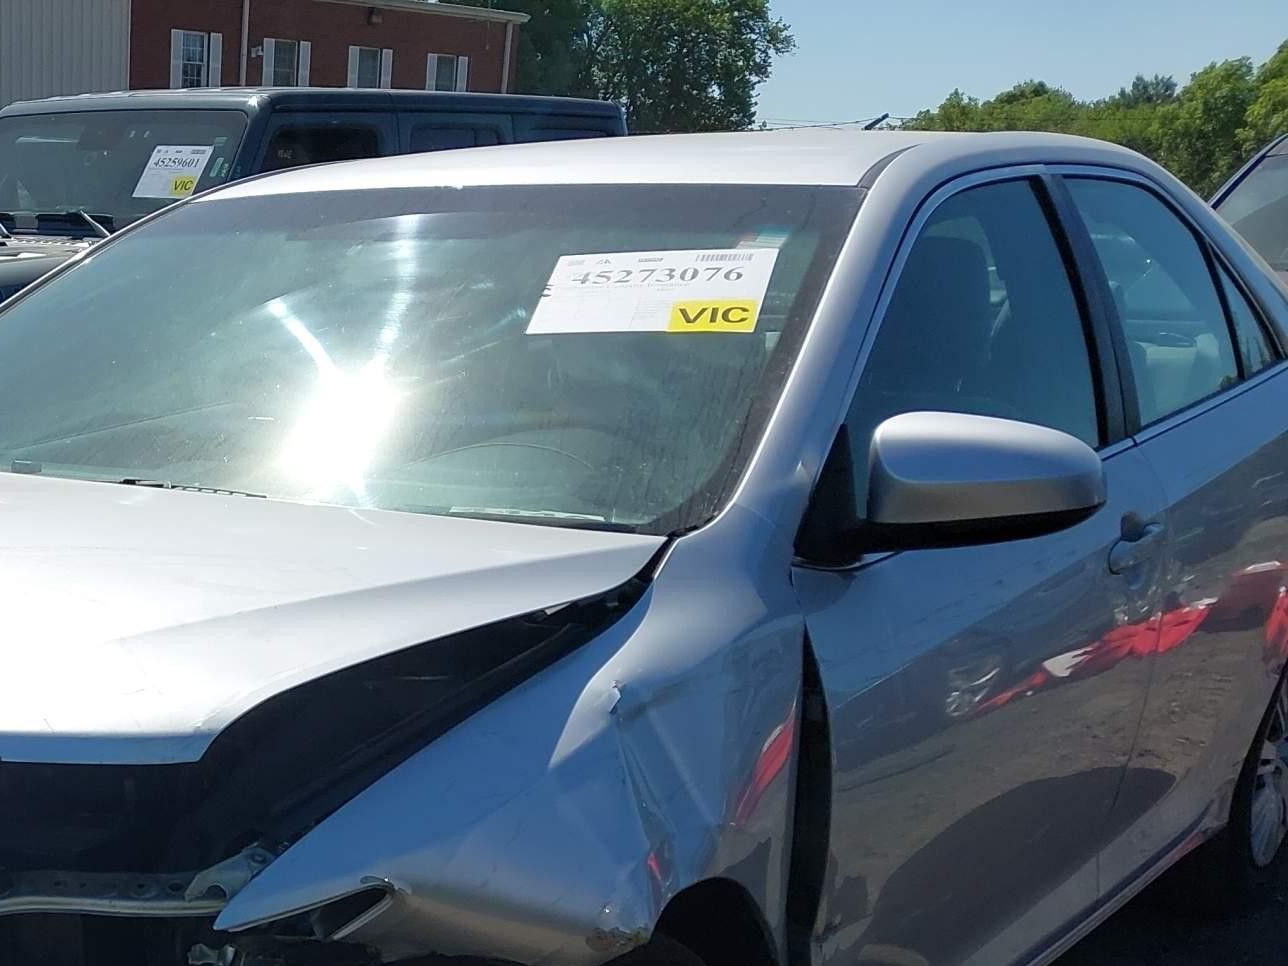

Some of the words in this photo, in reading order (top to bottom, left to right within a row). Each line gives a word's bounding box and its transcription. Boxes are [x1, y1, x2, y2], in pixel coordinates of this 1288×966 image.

[153, 157, 200, 168] 45259601
[174, 180, 193, 191] VIC
[571, 266, 744, 284] 45273076
[678, 306, 750, 324] VIC
